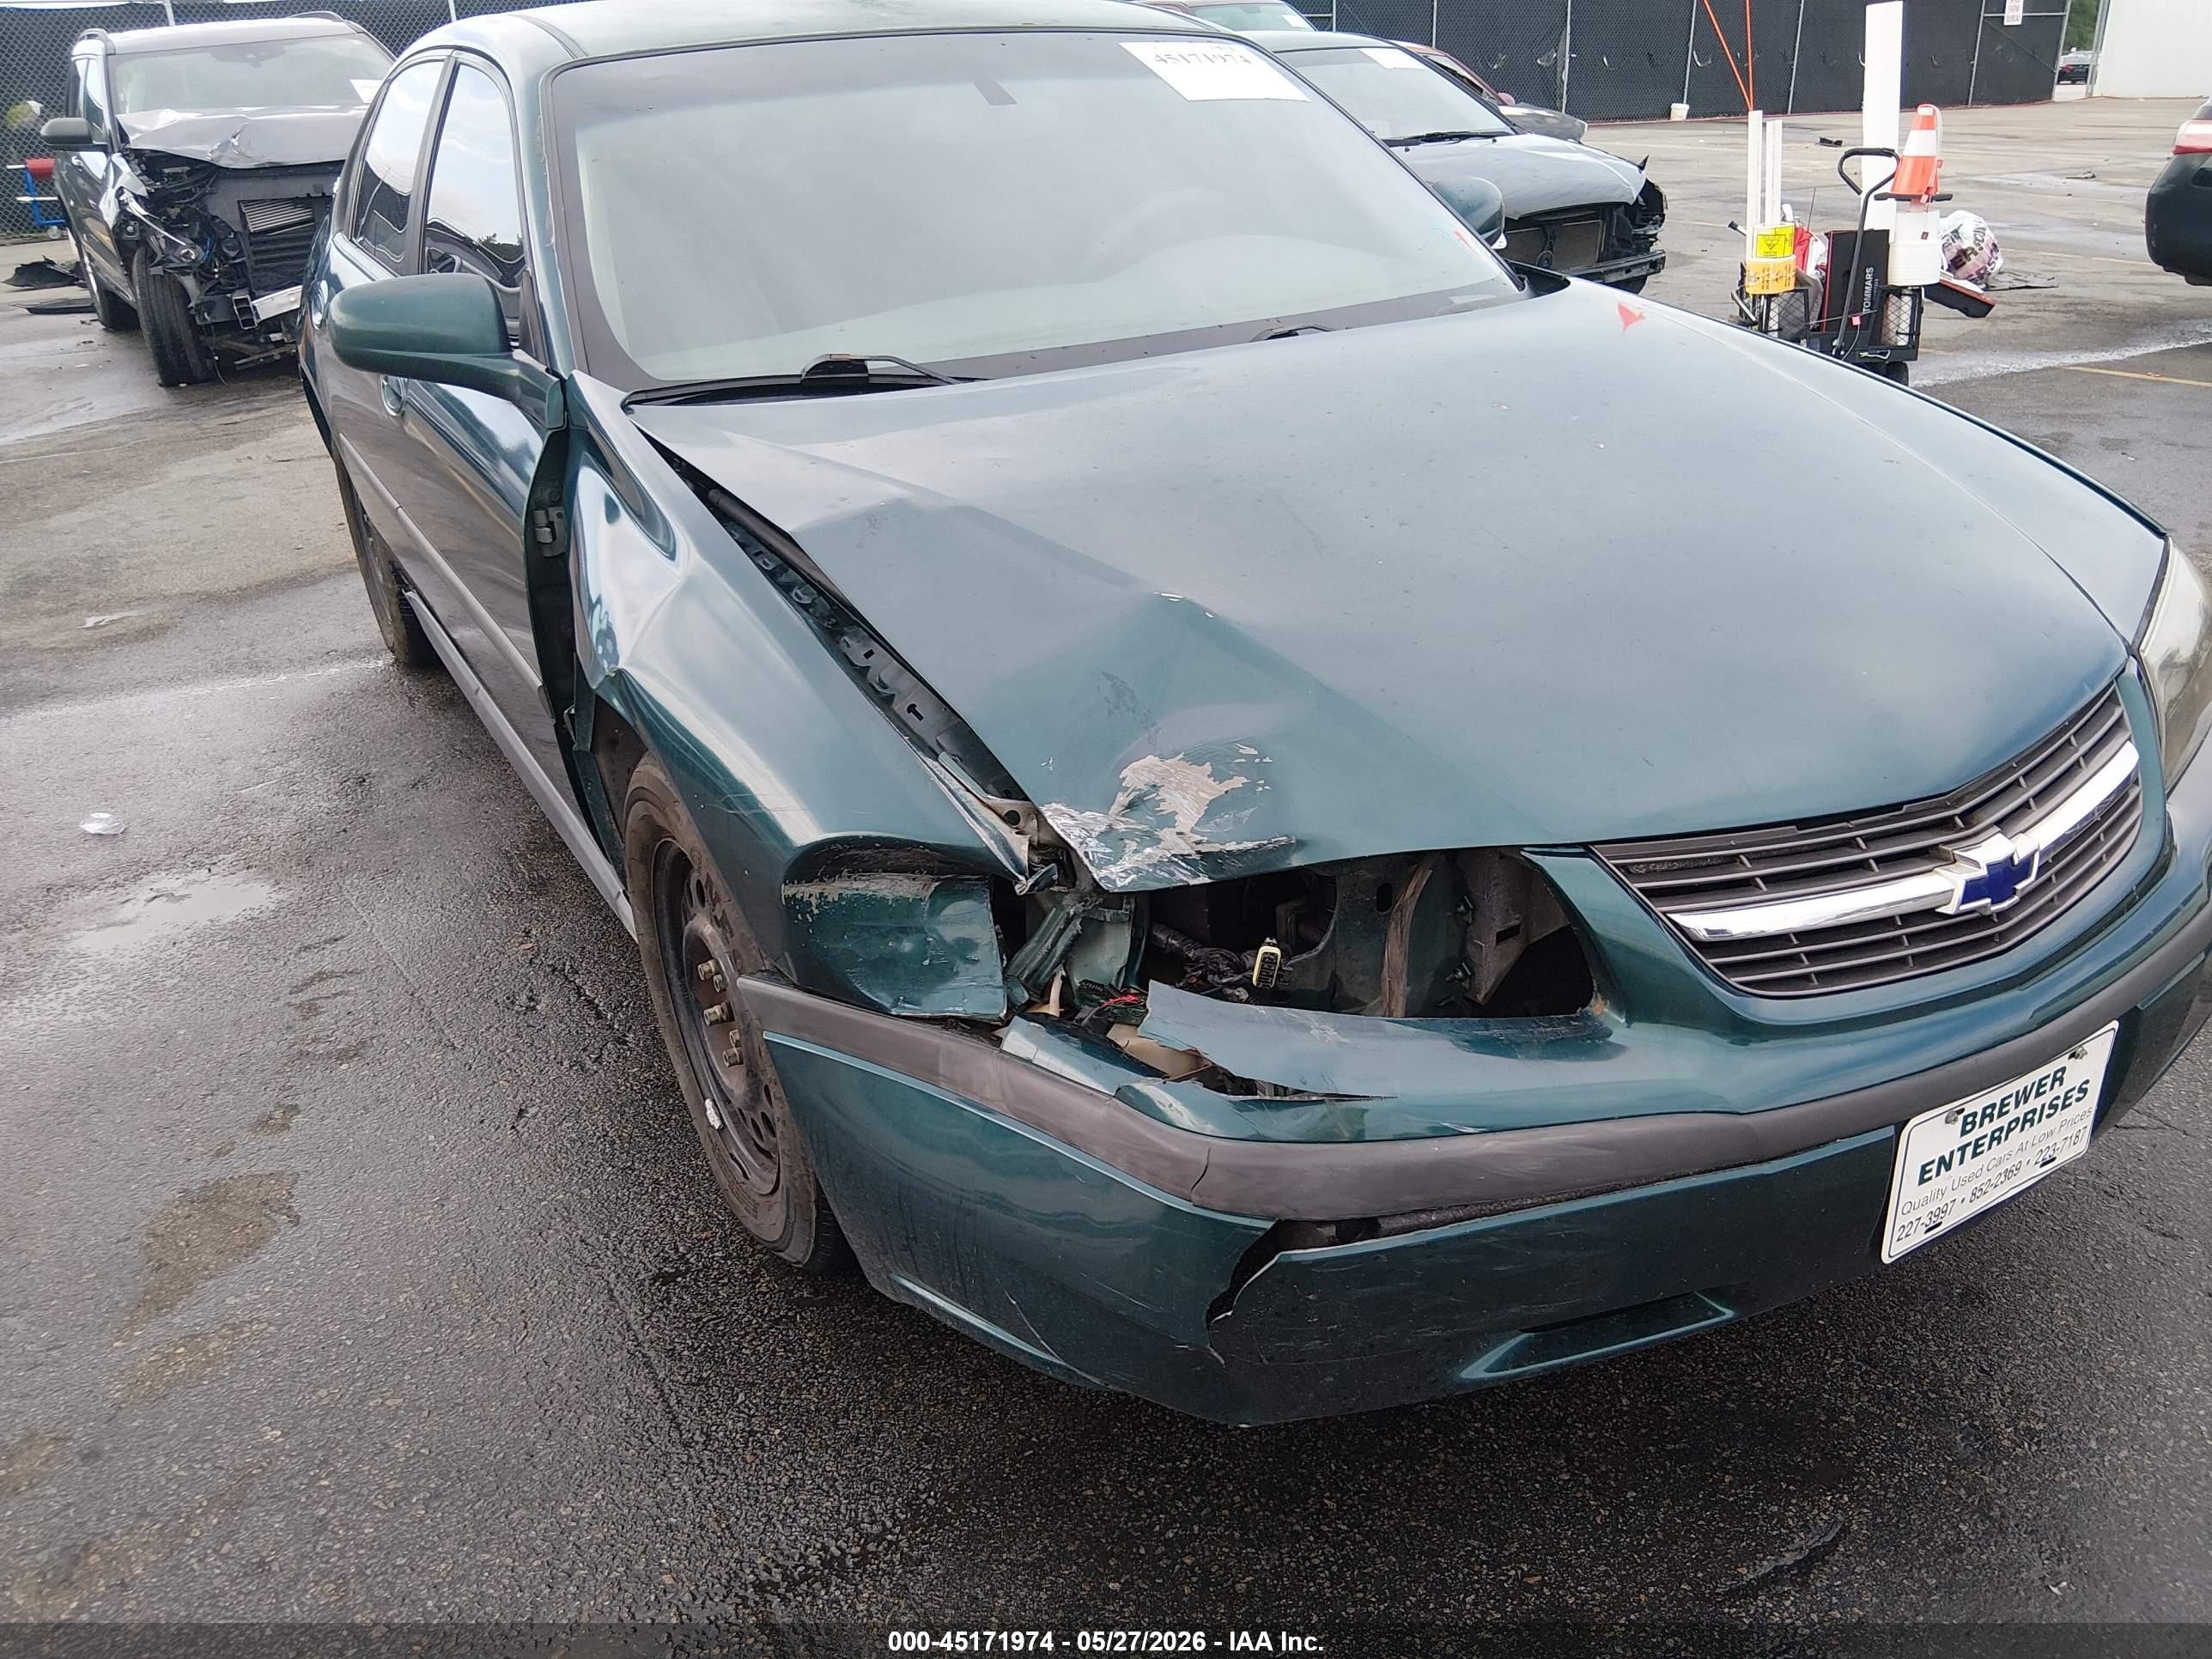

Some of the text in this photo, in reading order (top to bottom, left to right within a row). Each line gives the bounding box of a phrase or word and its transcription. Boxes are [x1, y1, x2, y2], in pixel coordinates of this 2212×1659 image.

[1863, 267, 1874, 313] TOMMARS
[1917, 1079, 2090, 1187] ENTERPRISES
[1960, 1065, 2067, 1138] BREWER
[1896, 1198, 1957, 1243] 227-3997
[1969, 1160, 2022, 1203] 852-2369
[2034, 1125, 2087, 1165] 223-7187
[1901, 1107, 2093, 1216] Quality Used Cars At Low Prices
